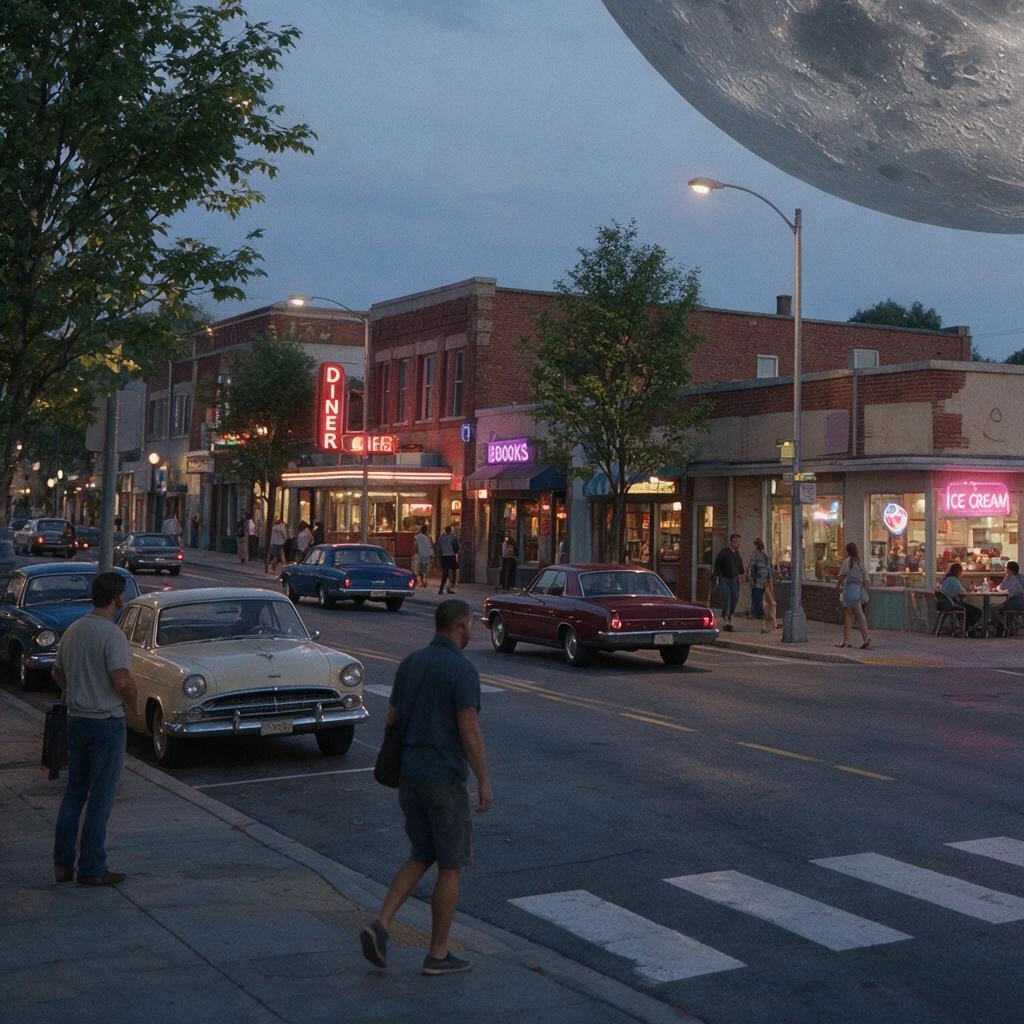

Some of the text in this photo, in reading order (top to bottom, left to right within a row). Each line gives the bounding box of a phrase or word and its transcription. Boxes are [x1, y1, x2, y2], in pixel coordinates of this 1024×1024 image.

[324, 366, 341, 450] DINER
[946, 492, 1009, 511] ICE CREAM
